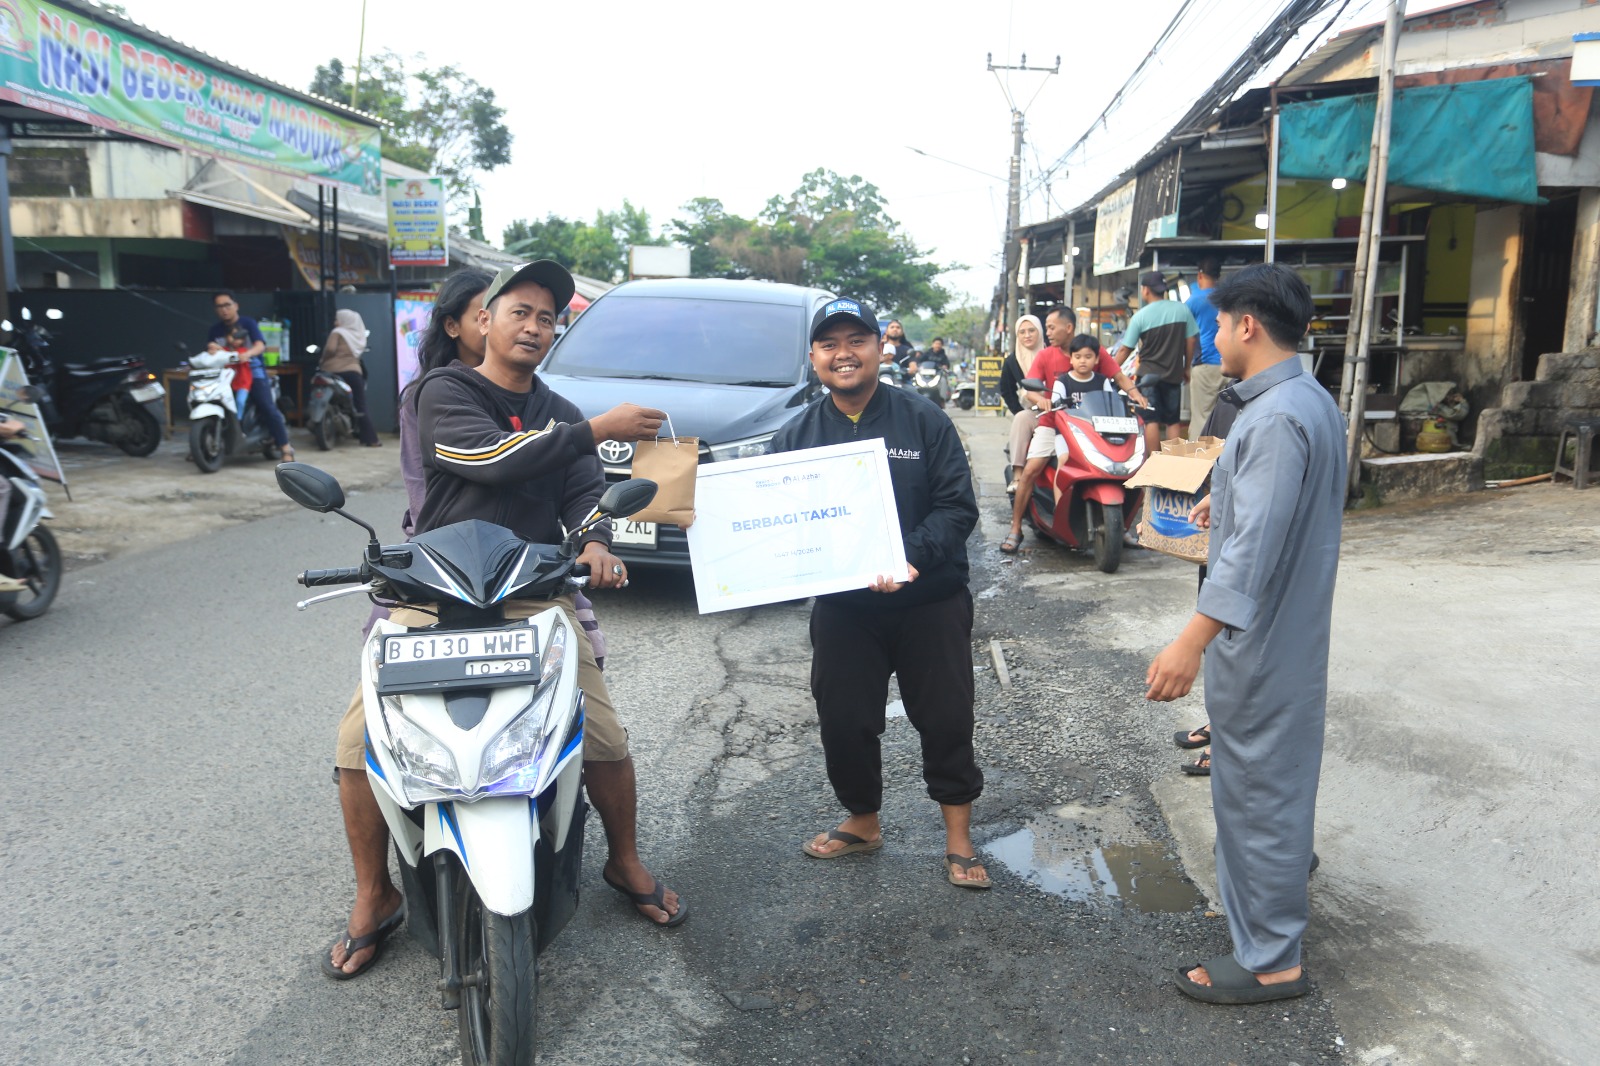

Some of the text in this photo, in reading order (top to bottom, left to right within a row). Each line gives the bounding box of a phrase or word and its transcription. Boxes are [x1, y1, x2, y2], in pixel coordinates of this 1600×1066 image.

[38, 8, 111, 98] NASI
[119, 41, 206, 108] BEBEK
[209, 75, 267, 127] KHAS
[268, 96, 346, 173] MADURA
[837, 302, 858, 311] AZHAR
[889, 447, 920, 457] Al Azhar
[801, 473, 821, 481] Azhar
[1153, 490, 1197, 518] OASIS
[731, 505, 852, 533] BERBAGI TAKJIL
[389, 633, 527, 660] B 6130 WWF
